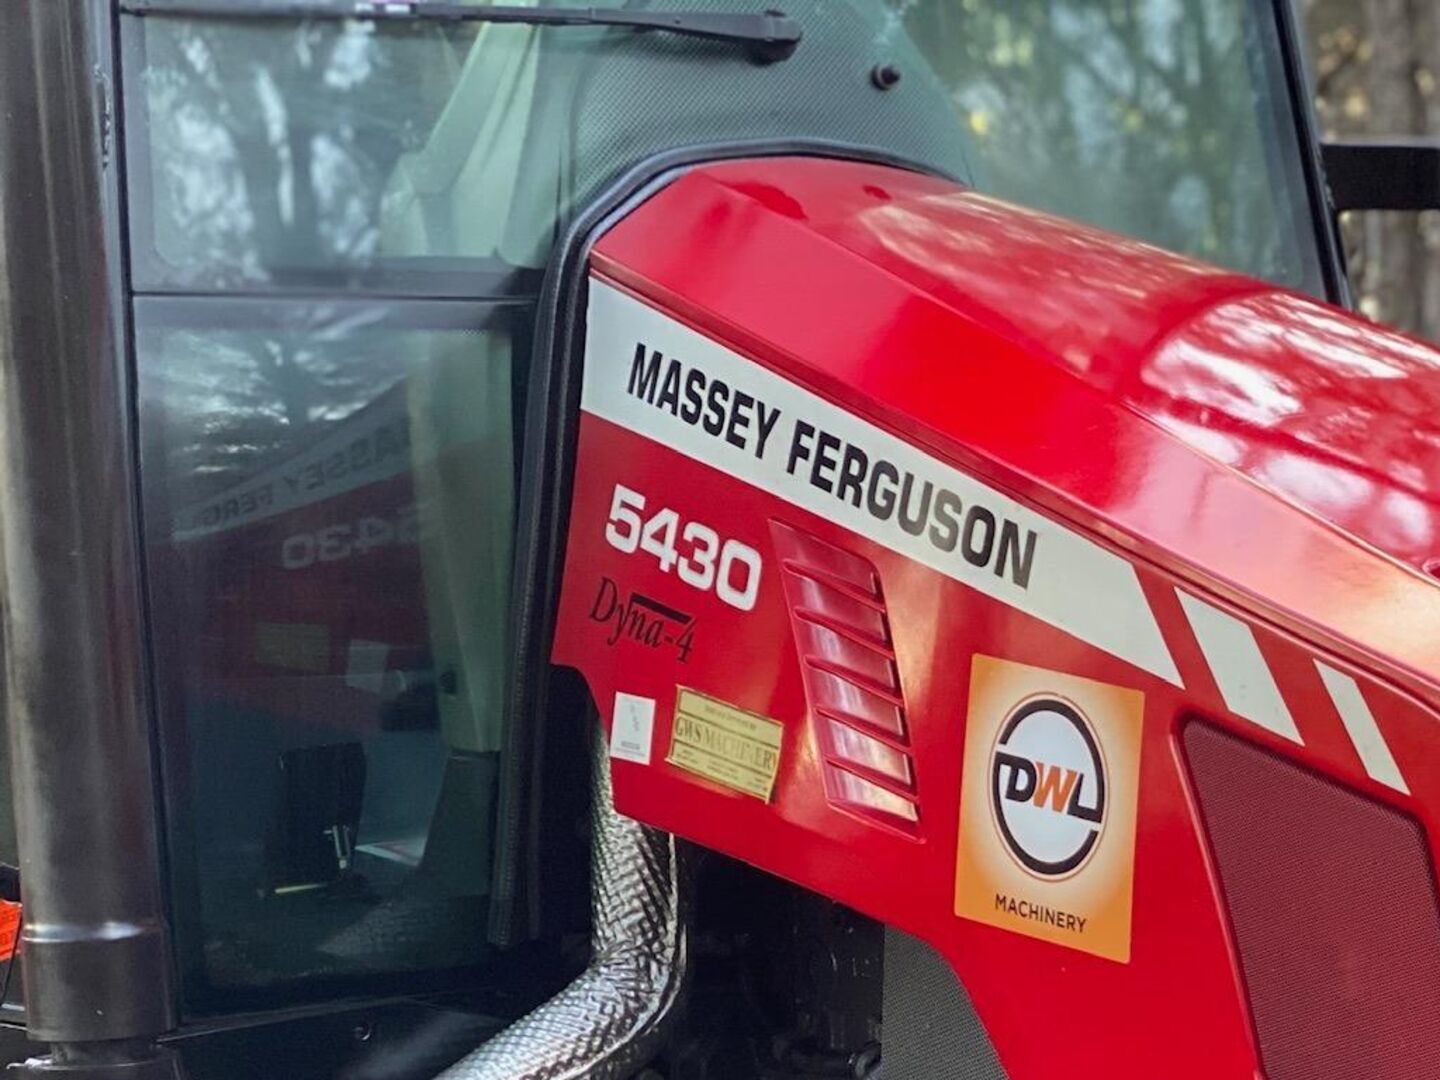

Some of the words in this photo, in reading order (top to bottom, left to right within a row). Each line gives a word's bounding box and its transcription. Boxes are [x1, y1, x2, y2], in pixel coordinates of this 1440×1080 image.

[626, 342, 781, 460] MASSEY
[786, 419, 1038, 590] FERGUSON
[605, 483, 763, 611] 5430
[589, 576, 698, 664] Dyna-4
[675, 716, 703, 742] GWS
[995, 751, 1102, 824] DWL
[994, 894, 1087, 934] MACHINERY
